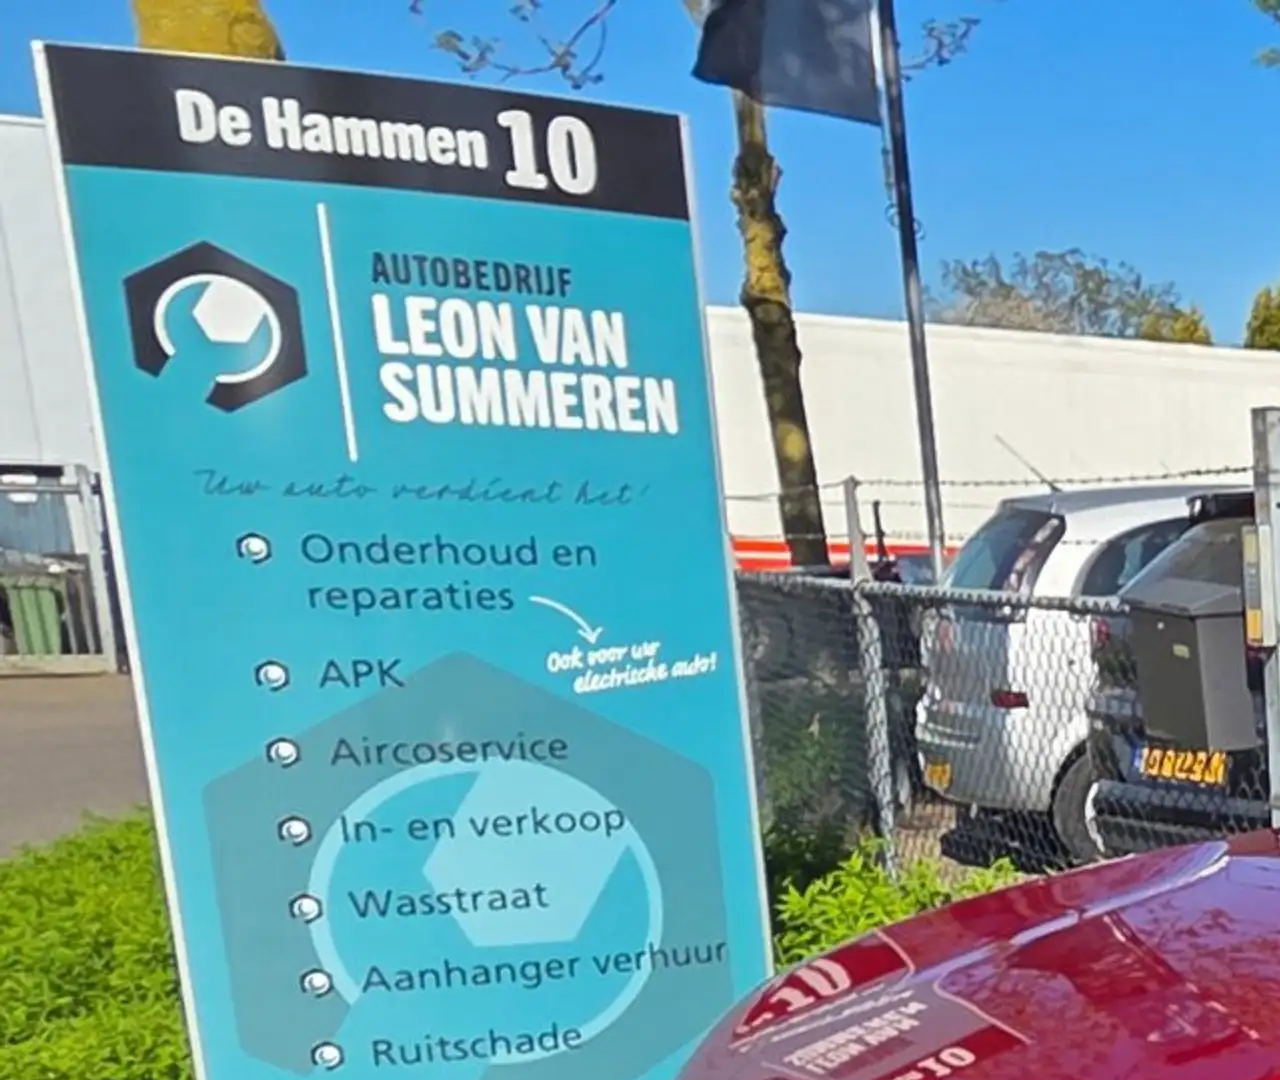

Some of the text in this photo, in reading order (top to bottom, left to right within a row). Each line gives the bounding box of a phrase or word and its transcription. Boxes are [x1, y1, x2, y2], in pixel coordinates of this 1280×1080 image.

[175, 88, 597, 195] De Hammen 10
[371, 252, 573, 297] AUTOBEDRIJF
[371, 294, 628, 368] LEON VAN
[379, 364, 680, 435] SUMMEREN
[193, 469, 270, 496] Uw
[283, 472, 377, 499] auto
[300, 533, 596, 568] Onderhoud en
[308, 580, 515, 617] reparaties
[318, 658, 406, 690] APK
[546, 640, 661, 673] Ook voor uw
[671, 651, 718, 678] auto!
[330, 733, 569, 769] Aircoservice
[340, 806, 626, 844] In- en verkoop
[347, 882, 550, 919] Wasstraat
[361, 937, 728, 994] Aanhanger verhuur
[372, 1024, 584, 1068] Ruitschade
